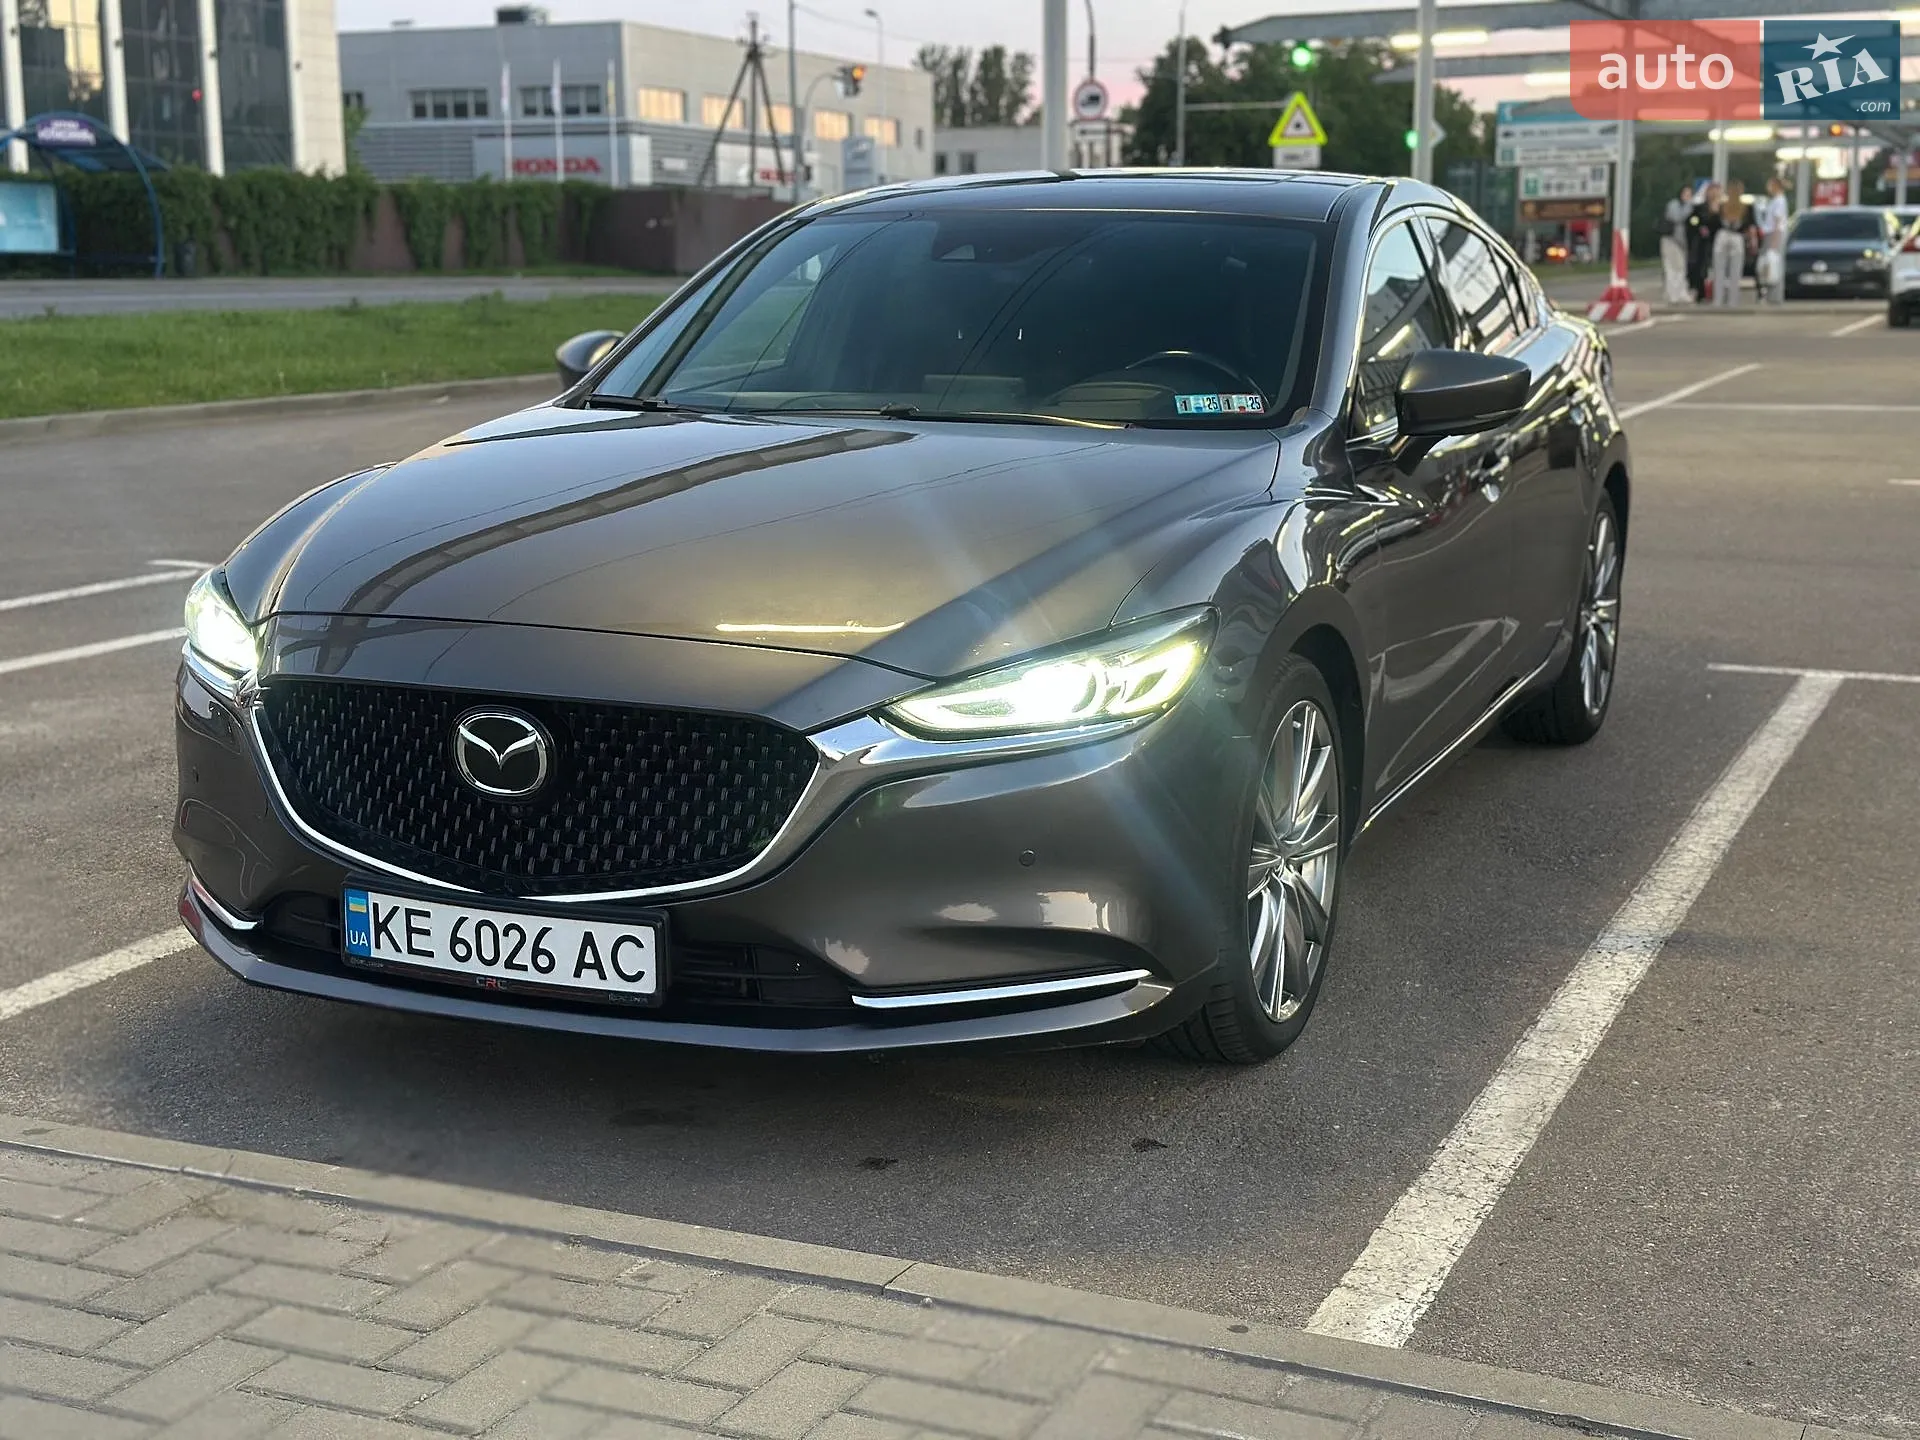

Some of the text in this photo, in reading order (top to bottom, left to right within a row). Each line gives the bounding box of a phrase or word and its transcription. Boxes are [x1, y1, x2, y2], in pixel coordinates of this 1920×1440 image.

[350, 930, 369, 947] UA
[372, 901, 645, 983] KE 6026 AC
